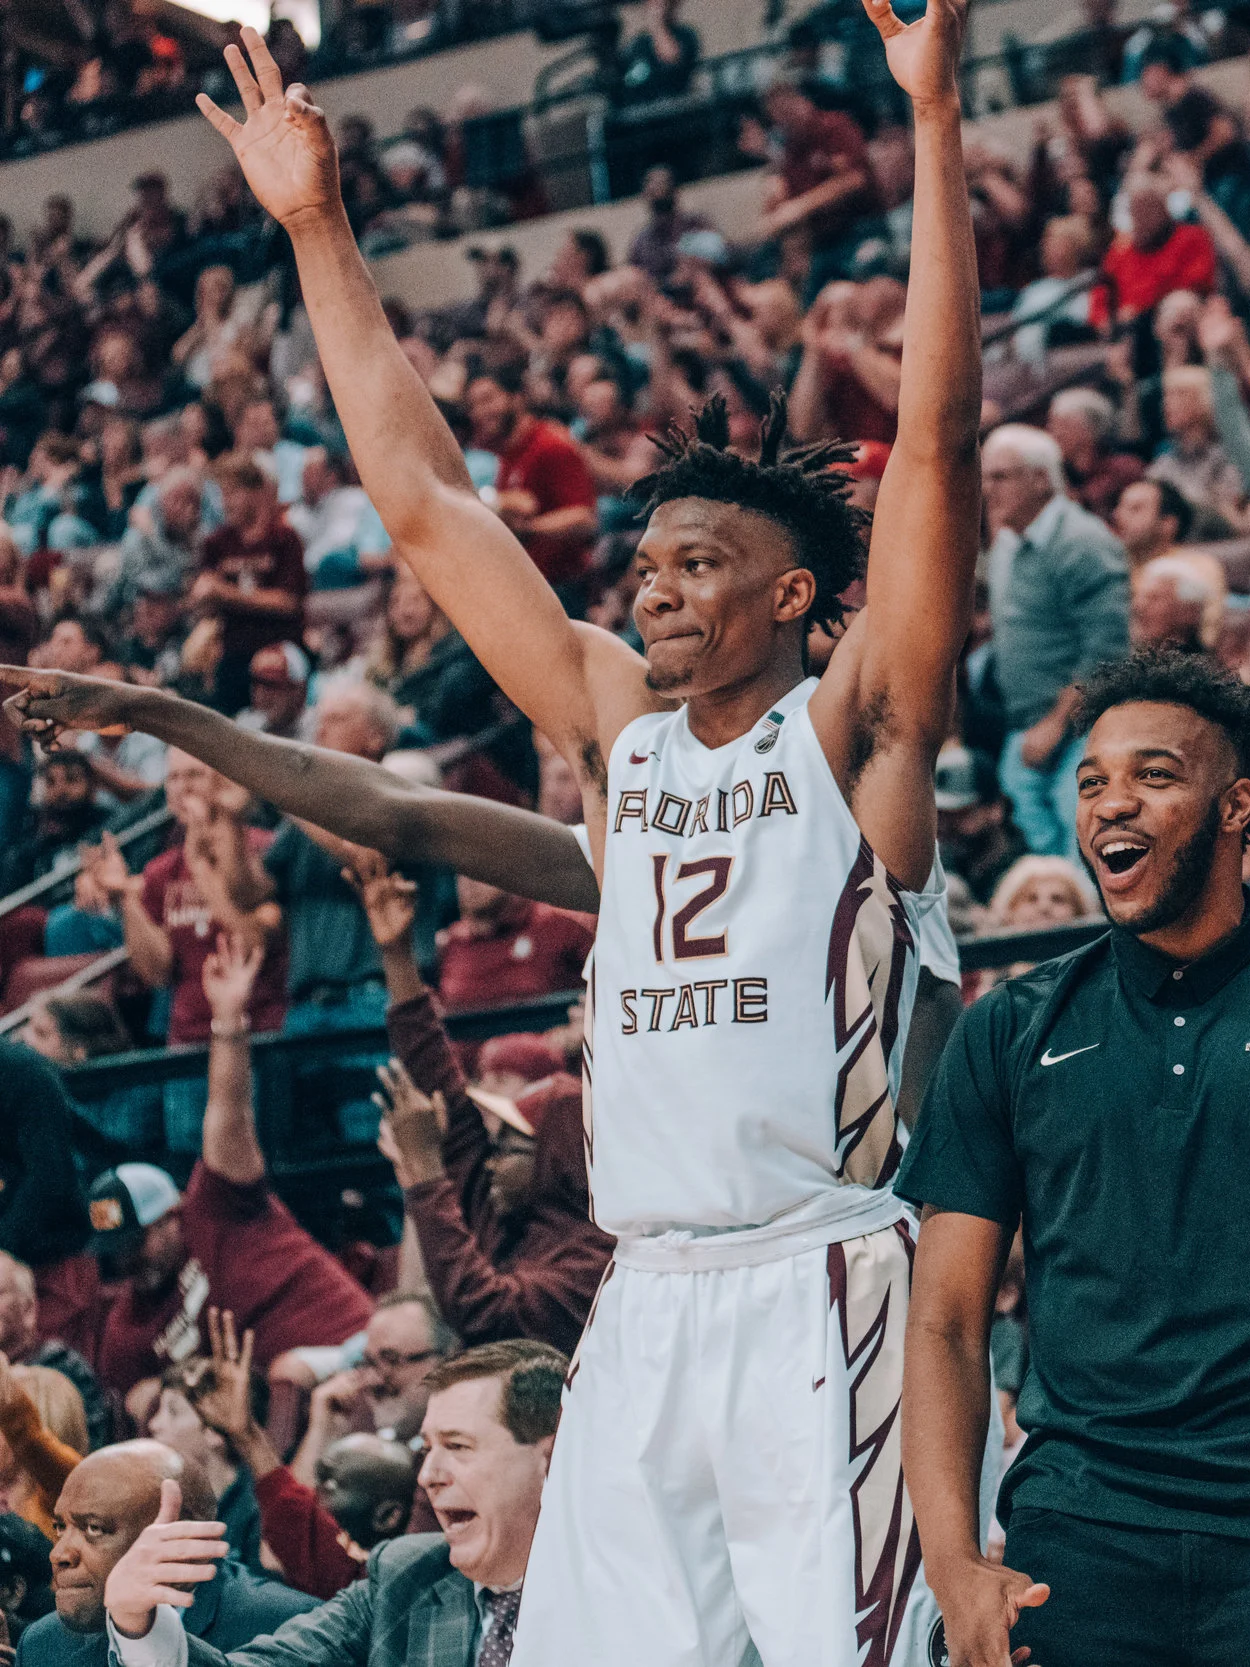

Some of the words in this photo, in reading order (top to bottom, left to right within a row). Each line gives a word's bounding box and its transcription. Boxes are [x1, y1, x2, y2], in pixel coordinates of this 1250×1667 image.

[613, 771, 798, 838] FLORIDA
[650, 853, 735, 965] 12
[620, 977, 768, 1035] STATE
